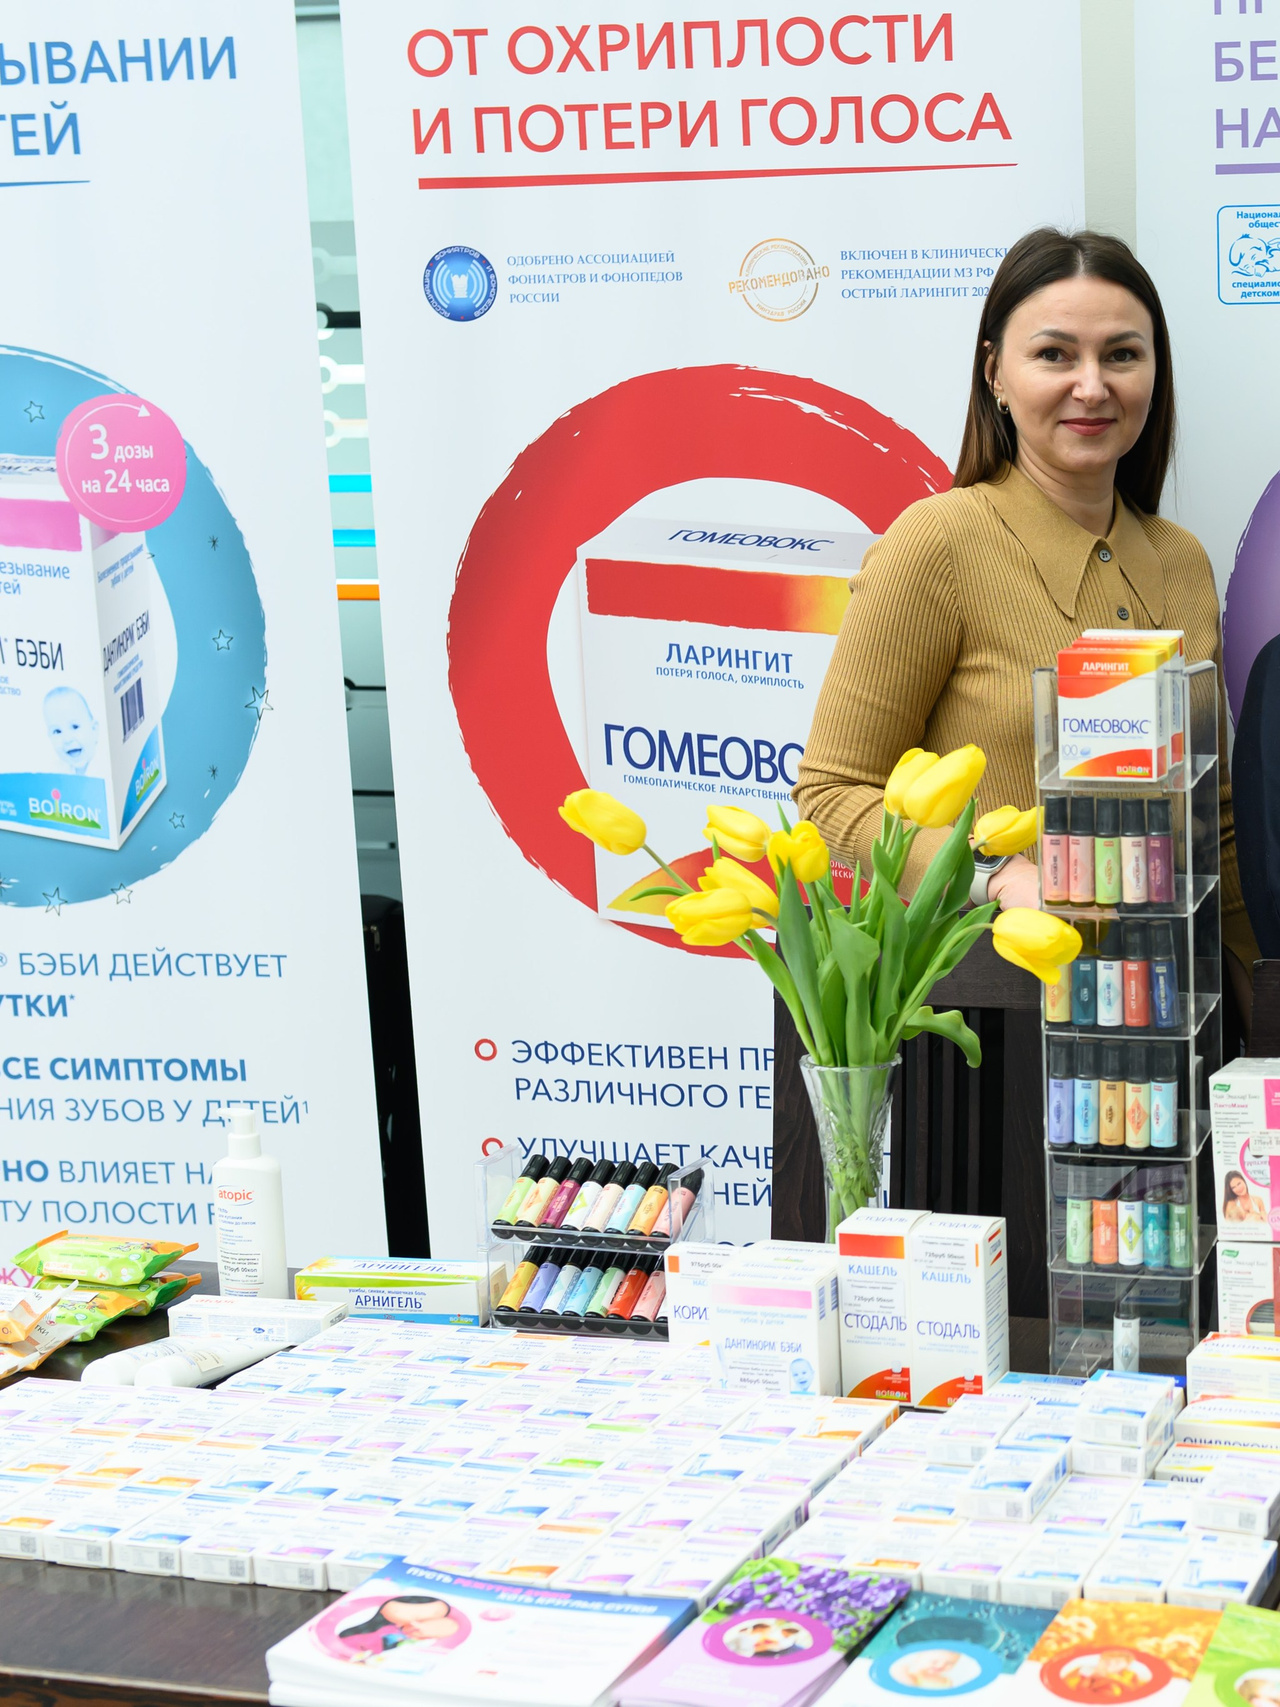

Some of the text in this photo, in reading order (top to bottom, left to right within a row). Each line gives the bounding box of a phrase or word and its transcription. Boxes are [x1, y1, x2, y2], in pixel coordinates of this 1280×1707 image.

[407, 13, 954, 78] ОТ ОХРИПЛОСТИ
[0, 101, 81, 156] ЕЙ
[413, 92, 1012, 155] И ПОТЕРИ ГОЛОСА
[507, 250, 675, 267] ОДОБРЕНО АССОЦИАЦИЕЙ
[840, 249, 908, 261] ВКЛЮЧЕН
[911, 249, 918, 260] В
[508, 271, 683, 285] ФОНИАТРОВ И ФОНОПЕДОВ
[728, 265, 831, 294] РЕКОМЕНДОВАНО
[841, 267, 994, 280] РЕКОМЕНДАЦИИ МЗ РФ
[510, 293, 560, 303] РОССИИ
[841, 286, 968, 299] ОСТРЫЙ ЛАРИНГИТ
[89, 424, 154, 463] 3 дозы
[82, 469, 170, 494] на 24 часа
[668, 530, 831, 552] ГОМЕОВОКС
[15, 638, 64, 671] БЭБИ
[666, 643, 793, 674] ЛАРИНГИТ
[1082, 661, 1130, 672] ЛАРИНГИТ
[656, 667, 805, 689] ПОТЕРЯ ГОЛОСА, ОХРИПЛОСТЬ
[1062, 718, 1151, 734] ГОМЕОВОКС
[1116, 764, 1150, 774] BOIRON
[623, 774, 716, 793] ГОМЕОПАТИЧЕСКОЕ
[29, 790, 101, 822] BOIRON
[19, 947, 287, 981] БЭБИ ДЕЙСТВУЕТ
[511, 1040, 728, 1070] ЭФФЕКТИВЕН
[0, 1057, 247, 1081] СЕ СИМПТОМЫ
[515, 1078, 772, 1109] РАЗЛИЧНОГО ГЕ
[65, 1099, 165, 1122] ЗУБОВ
[174, 1100, 192, 1123] У
[517, 1137, 690, 1168] УЛУЧШАЕТ
[2, 1160, 175, 1184] НО ВЛИЯЕТ
[218, 1189, 253, 1203] atopic
[43, 1202, 197, 1225] ПОЛОСТИ
[848, 1264, 897, 1277] КАШЕЛЬ
[921, 1271, 971, 1284] КАШЕЛЬ
[355, 1295, 422, 1309] АРНИГЕЛЬ
[673, 1305, 709, 1320] КОРИ
[844, 1313, 907, 1332] СТОДАЛЬ
[917, 1321, 980, 1339] СТОДАЛЬ
[725, 1337, 802, 1353] ДАНТИНОРМ БЭБИ
